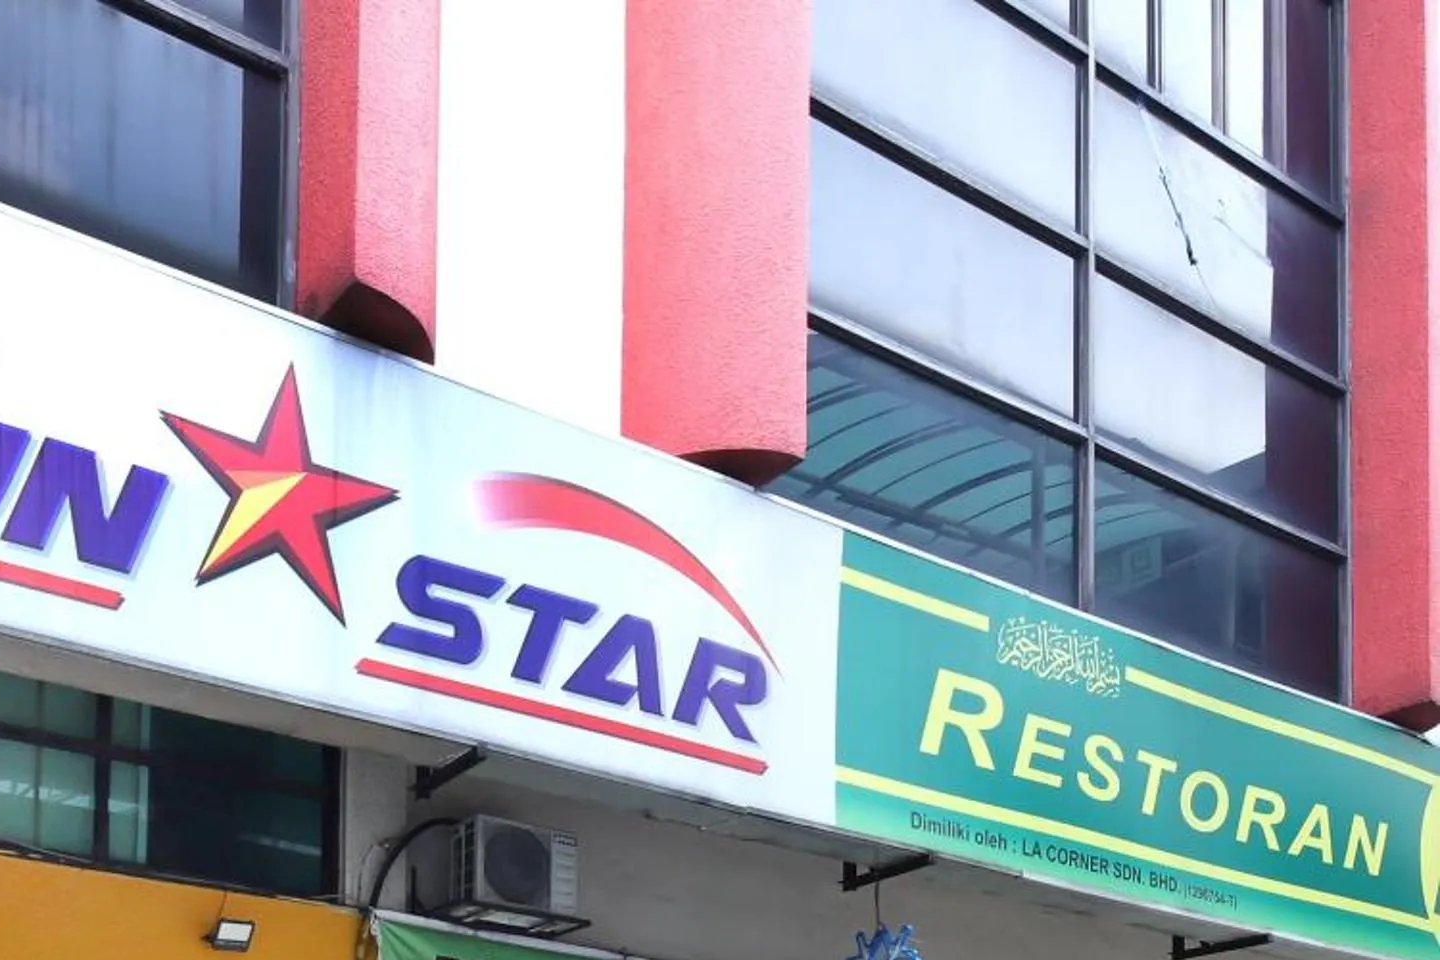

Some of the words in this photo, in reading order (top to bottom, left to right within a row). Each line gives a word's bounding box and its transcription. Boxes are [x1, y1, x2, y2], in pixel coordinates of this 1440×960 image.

[375, 553, 770, 745] STAR
[910, 811, 970, 843] Dimiliki
[975, 829, 1008, 851] oleh
[1022, 839, 1042, 860] LA
[1045, 844, 1110, 875] CORNER
[1112, 861, 1146, 886] SDN.
[1149, 872, 1182, 896] BHD.
[918, 668, 1389, 877] RESTORAN
